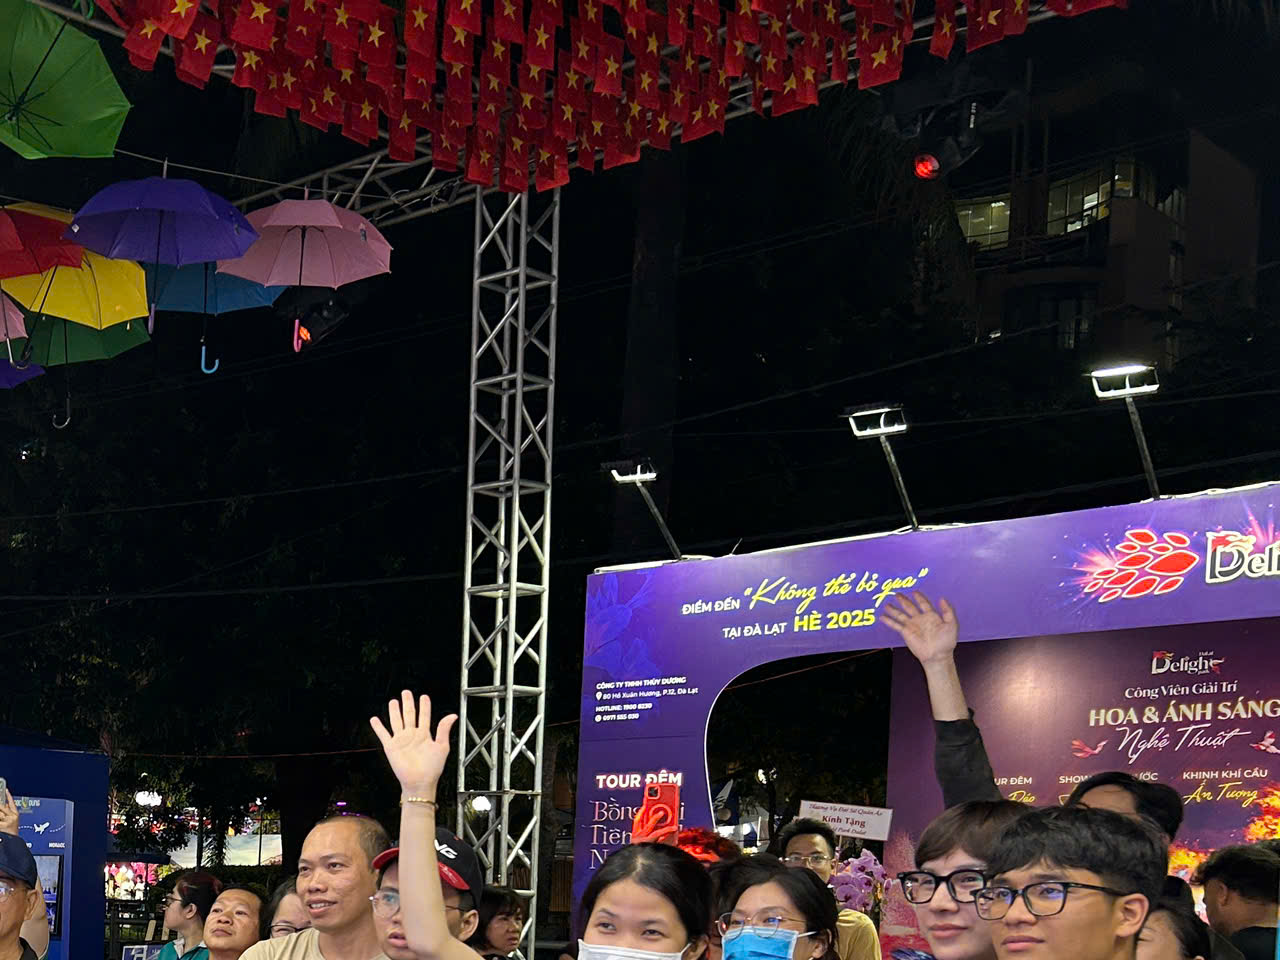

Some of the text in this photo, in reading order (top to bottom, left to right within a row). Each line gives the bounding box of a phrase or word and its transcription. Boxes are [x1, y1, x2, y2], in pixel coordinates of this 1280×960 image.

[682, 599, 712, 615] ĐIỂM
[714, 597, 741, 612] ĐẾN
[723, 608, 876, 639] TẠI ĐÀ LẠT HÈ 2025
[1125, 680, 1238, 699] Công Viên Giải Trí
[1089, 696, 1280, 727] HOA & ÁNH SÁNG
[1116, 723, 1252, 764] Nghệ Thuật
[596, 769, 682, 788] TOUR ĐÊM
[1010, 775, 1033, 785] ĐÊM
[1183, 767, 1268, 780] KHINH KHÍ CẦU
[822, 815, 866, 829] Kính Tặng
